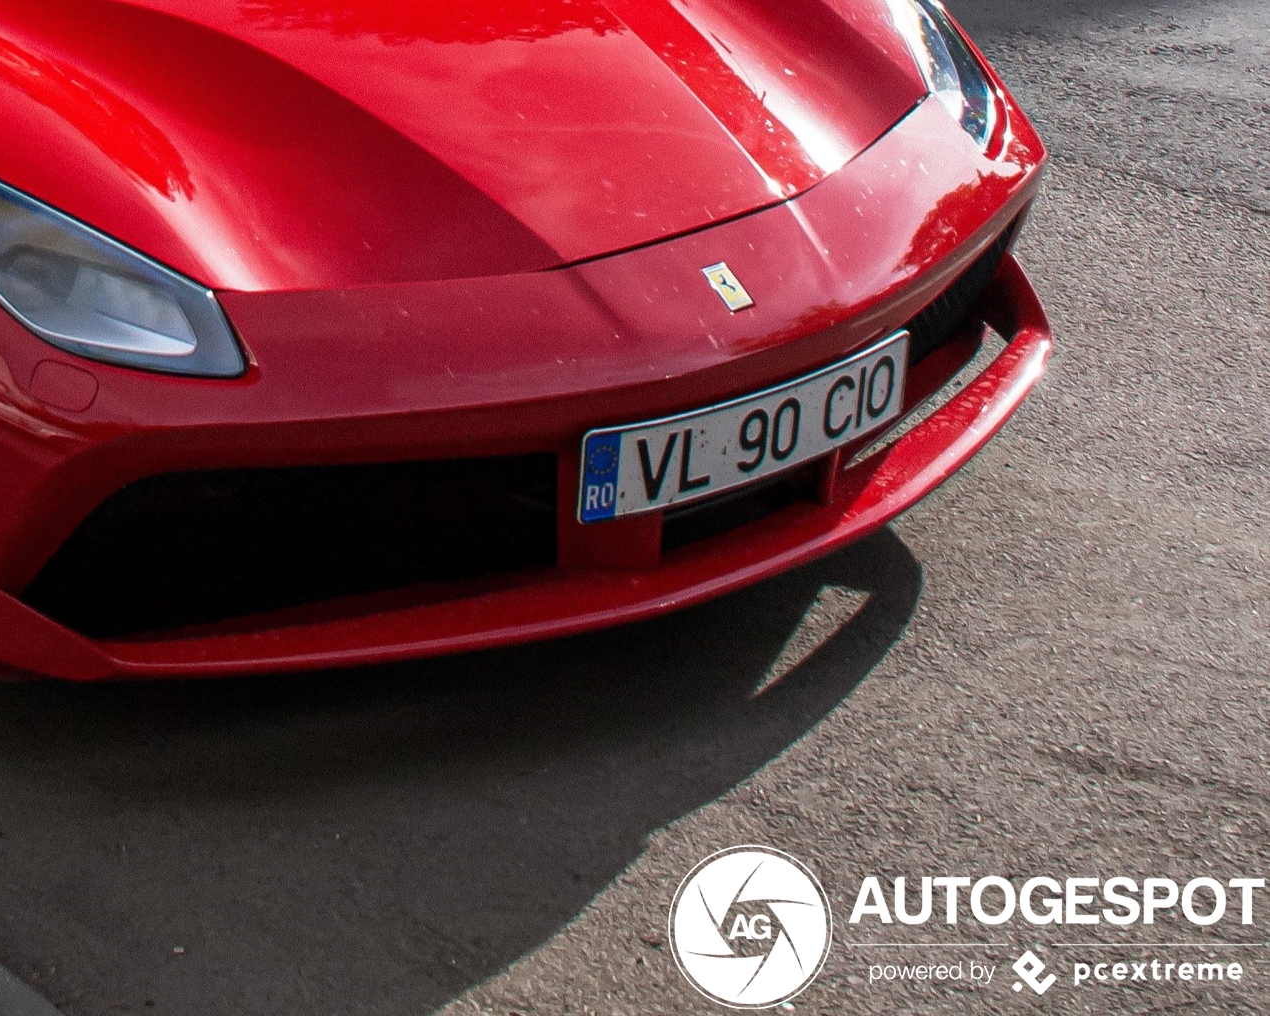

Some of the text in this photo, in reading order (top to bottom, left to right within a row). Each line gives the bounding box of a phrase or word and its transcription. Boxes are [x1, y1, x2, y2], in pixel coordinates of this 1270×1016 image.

[637, 355, 895, 501] VL 90 CIO
[586, 483, 615, 510] RO
